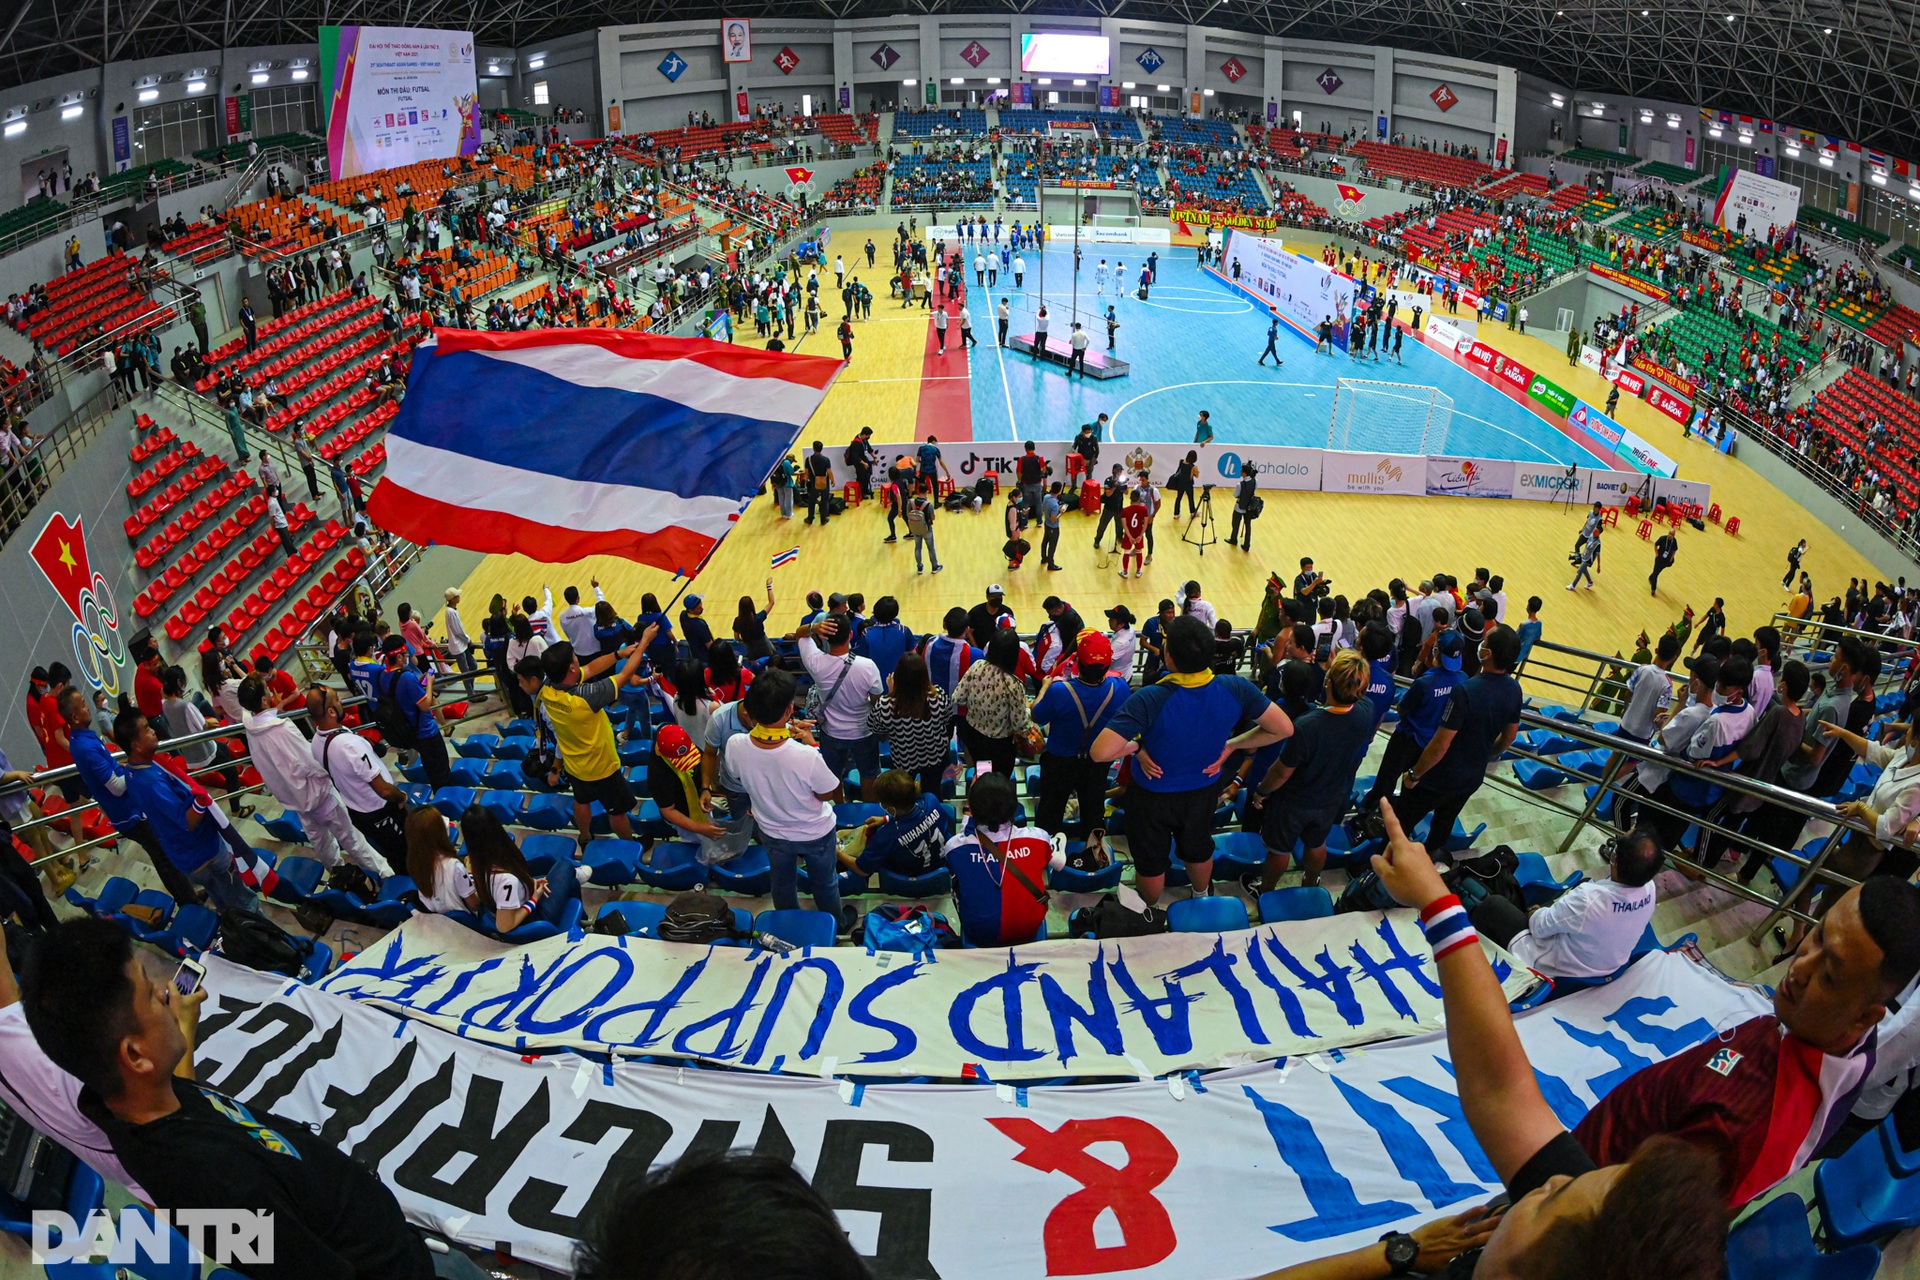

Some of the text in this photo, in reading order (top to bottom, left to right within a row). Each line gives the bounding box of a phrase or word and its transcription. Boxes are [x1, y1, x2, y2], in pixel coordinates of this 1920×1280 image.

[377, 87, 389, 95] MÔN
[1224, 216, 1253, 227] GOLDEN
[1676, 378, 1690, 394] NAM
[1348, 472, 1385, 485] mollis
[1131, 513, 1138, 528] 6
[361, 753, 372, 769] 7
[898, 809, 940, 847] MUHAMMAD
[970, 846, 1031, 863] THAAND
[503, 884, 512, 901] 7
[1612, 894, 1651, 912] THAILAND
